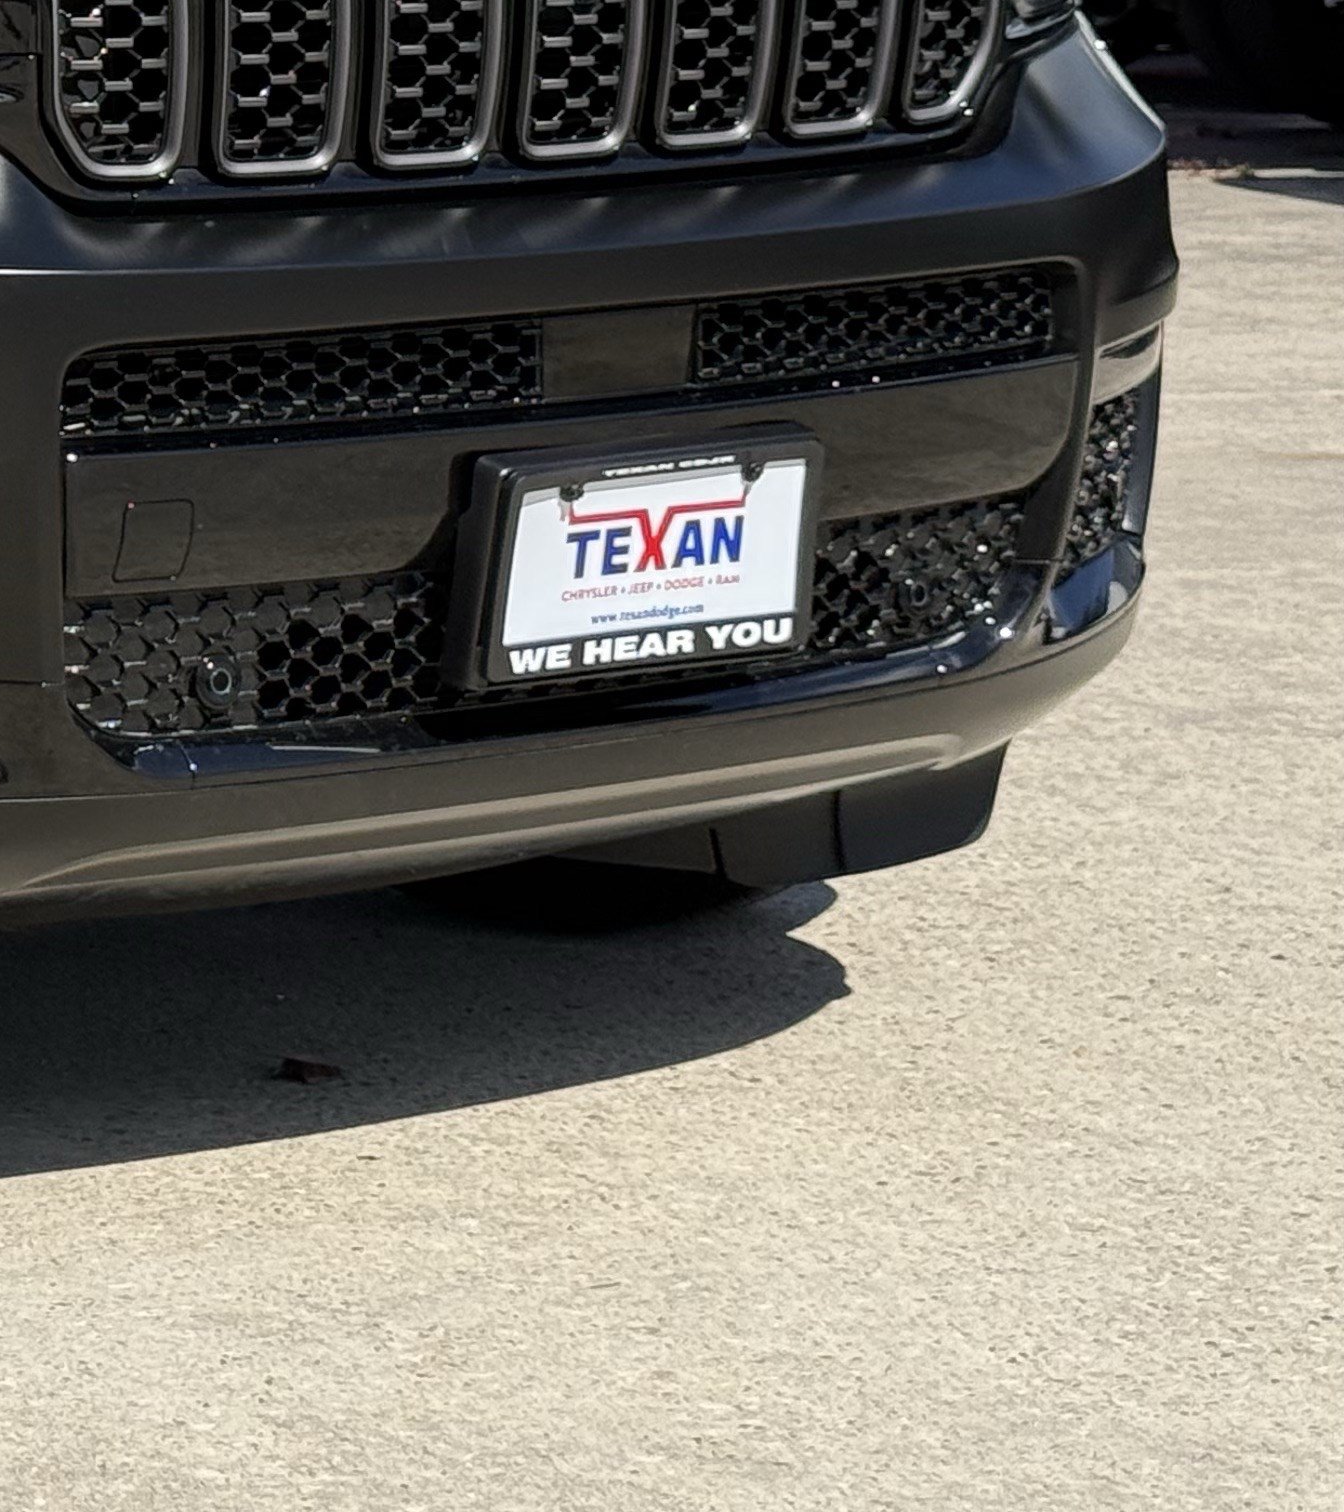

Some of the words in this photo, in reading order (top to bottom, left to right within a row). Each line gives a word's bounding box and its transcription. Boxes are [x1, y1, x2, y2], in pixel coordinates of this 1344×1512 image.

[566, 506, 745, 579] TEXAN
[561, 585, 618, 603] CHRYSLER
[627, 581, 655, 596] JEEP
[664, 576, 705, 591] DODGE
[510, 644, 573, 675] WE
[583, 629, 695, 666] HEAR
[707, 617, 794, 650] YOU
